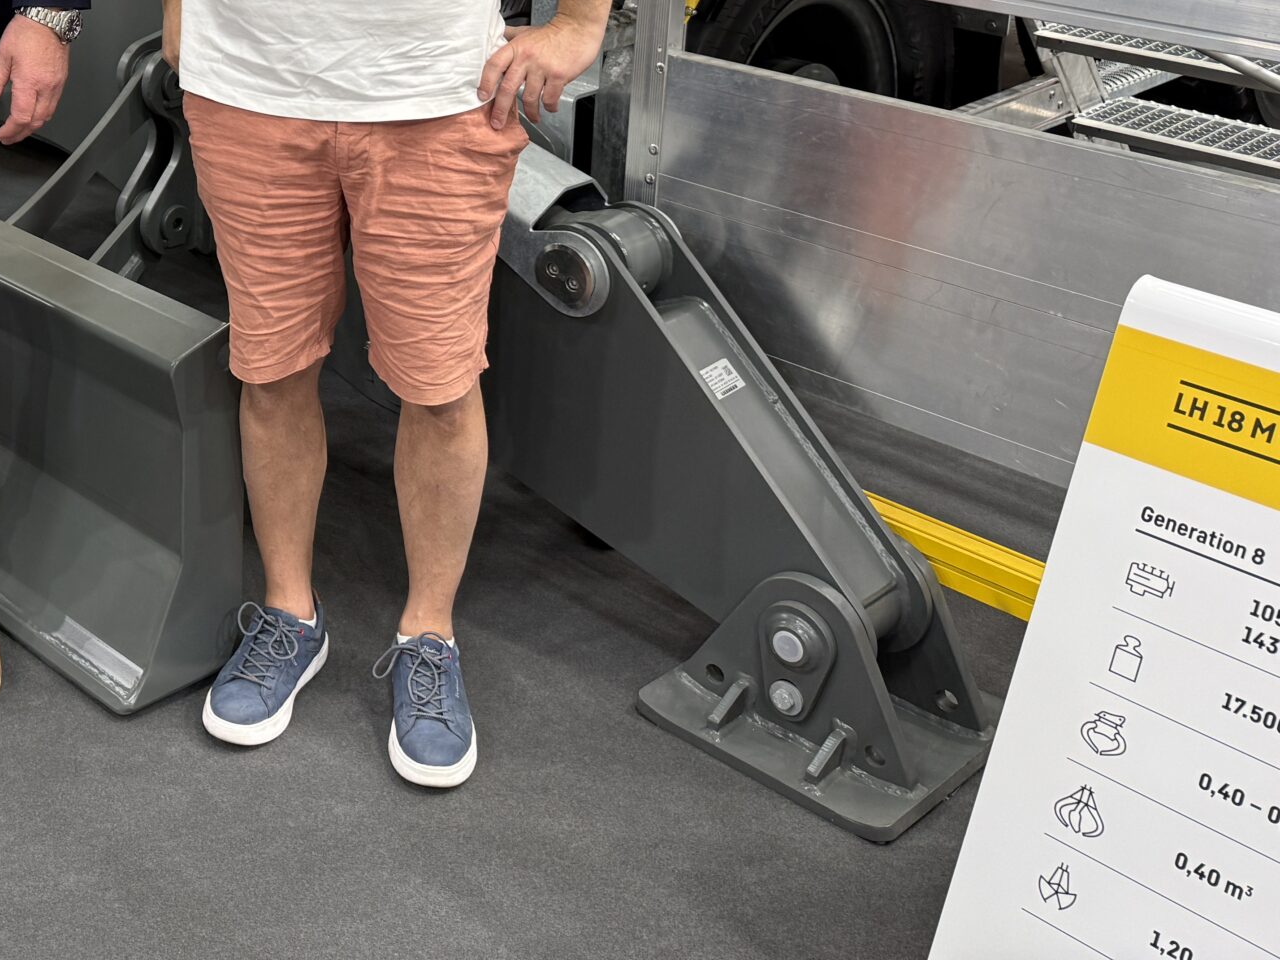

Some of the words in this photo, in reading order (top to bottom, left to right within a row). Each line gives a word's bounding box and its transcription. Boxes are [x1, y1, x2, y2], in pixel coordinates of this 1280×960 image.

[1173, 392, 1209, 422] LH
[1212, 404, 1246, 433] 18
[1250, 416, 1277, 444] M
[1140, 505, 1247, 560] Generation
[1251, 547, 1266, 566] 8
[1241, 625, 1280, 655] 143
[1198, 772, 1246, 808] 0,40
[1174, 851, 1221, 888] 0,40
[1149, 929, 1194, 960] 1,20
